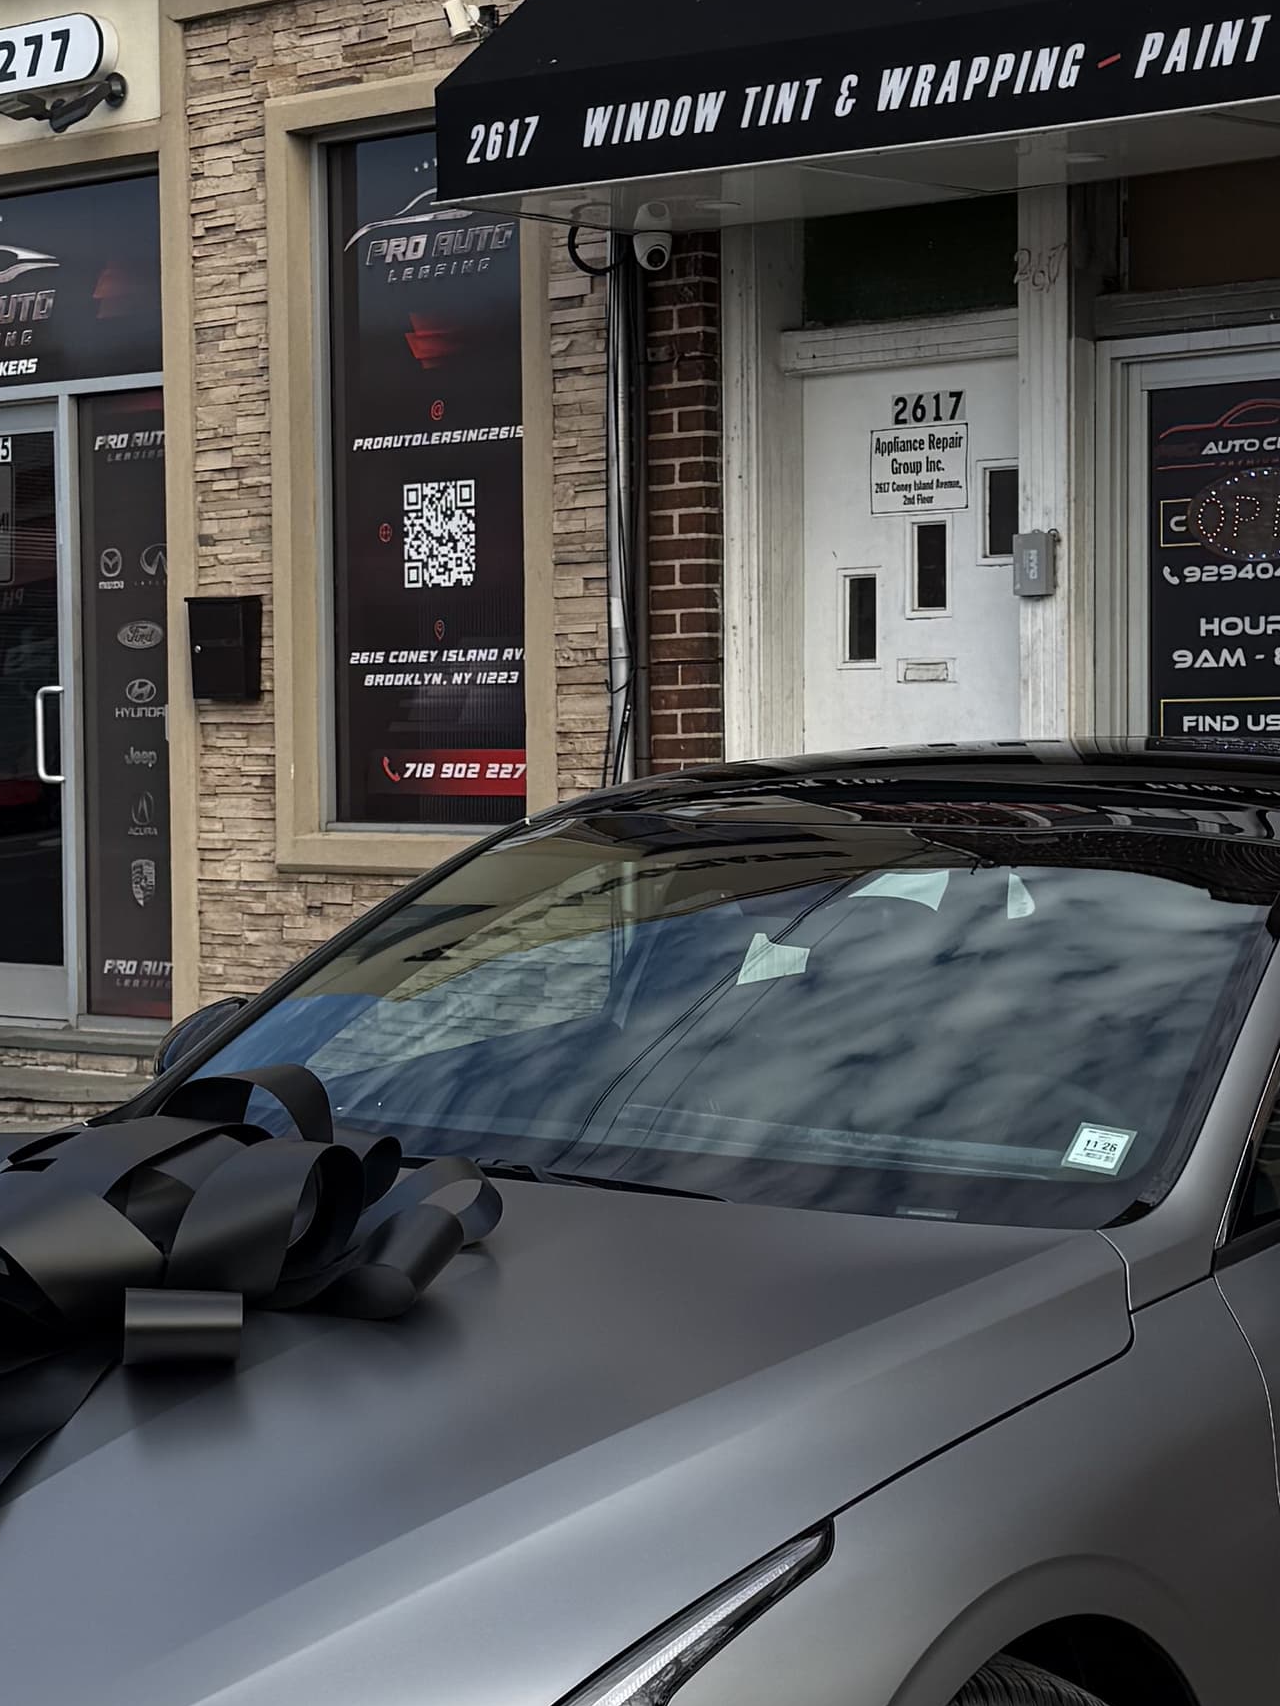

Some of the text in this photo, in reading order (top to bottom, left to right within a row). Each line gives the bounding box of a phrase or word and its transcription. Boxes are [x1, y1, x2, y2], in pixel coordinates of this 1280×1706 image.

[582, 89, 727, 149] WINDOW
[740, 75, 823, 130] TINT
[834, 74, 858, 118] &
[876, 42, 1086, 113] WRAPPING
[1134, 15, 1270, 78] PAINT
[466, 115, 540, 165] 2617
[365, 223, 515, 266] PRO AUTO
[894, 391, 963, 425] 2617
[94, 433, 128, 450] PRO
[352, 425, 525, 452] PROAUTOLEASING2615
[875, 431, 963, 457] Appliance Repair
[1201, 439, 1259, 456] AUTO
[891, 455, 945, 476] Group Inc.
[891, 481, 912, 493] Coney
[914, 479, 934, 491] Island
[349, 648, 526, 664] 2615 CONEY ISLAND AV
[1172, 648, 1246, 670] 9AM
[452, 672, 472, 685] NY
[476, 671, 519, 684] 11223
[115, 707, 165, 717] HYUNDA
[1182, 714, 1239, 732] FIND
[124, 746, 157, 767] Jeep
[403, 763, 435, 778] 718
[440, 763, 480, 778] 902
[104, 959, 137, 974] PRO
